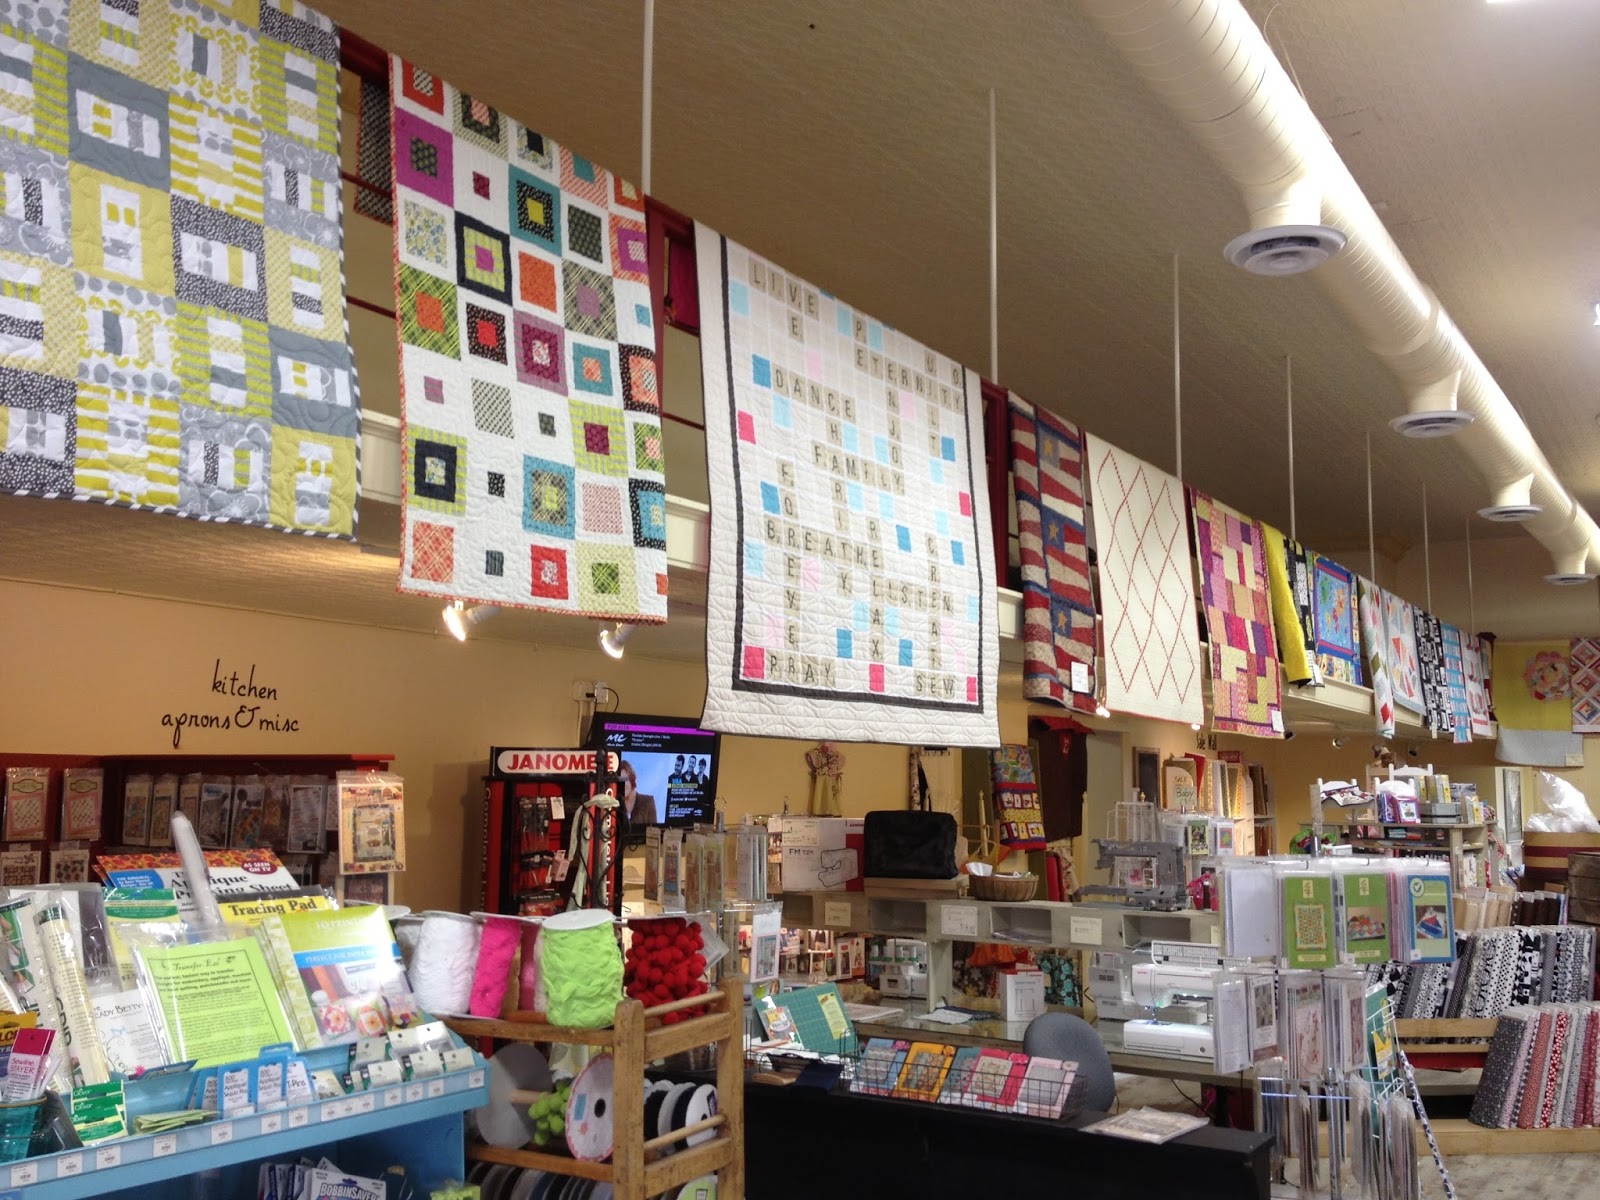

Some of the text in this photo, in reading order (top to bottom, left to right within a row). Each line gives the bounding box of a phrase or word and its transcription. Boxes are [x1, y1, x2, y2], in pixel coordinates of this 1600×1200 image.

[753, 265, 817, 314] LIVE
[856, 349, 962, 408] ETERNITY
[775, 369, 853, 418] DANCE
[814, 446, 902, 492] FAMILY
[767, 521, 879, 568] BREATHE
[872, 580, 951, 611] LISTEN
[212, 658, 277, 700] kitchen
[770, 655, 832, 681] PRAY
[915, 675, 954, 695] SEW
[161, 712, 231, 750] aprons
[259, 713, 300, 732] misc
[507, 753, 599, 770] JANOME
[1176, 787, 1195, 798] Baby
[249, 883, 293, 893] Sheet
[228, 898, 318, 916] Tracing Pad
[114, 1003, 141, 1014] BETTY
[9, 1066, 35, 1075] STAYER
[11, 1057, 35, 1067] Sewline
[74, 1102, 93, 1110] Clover
